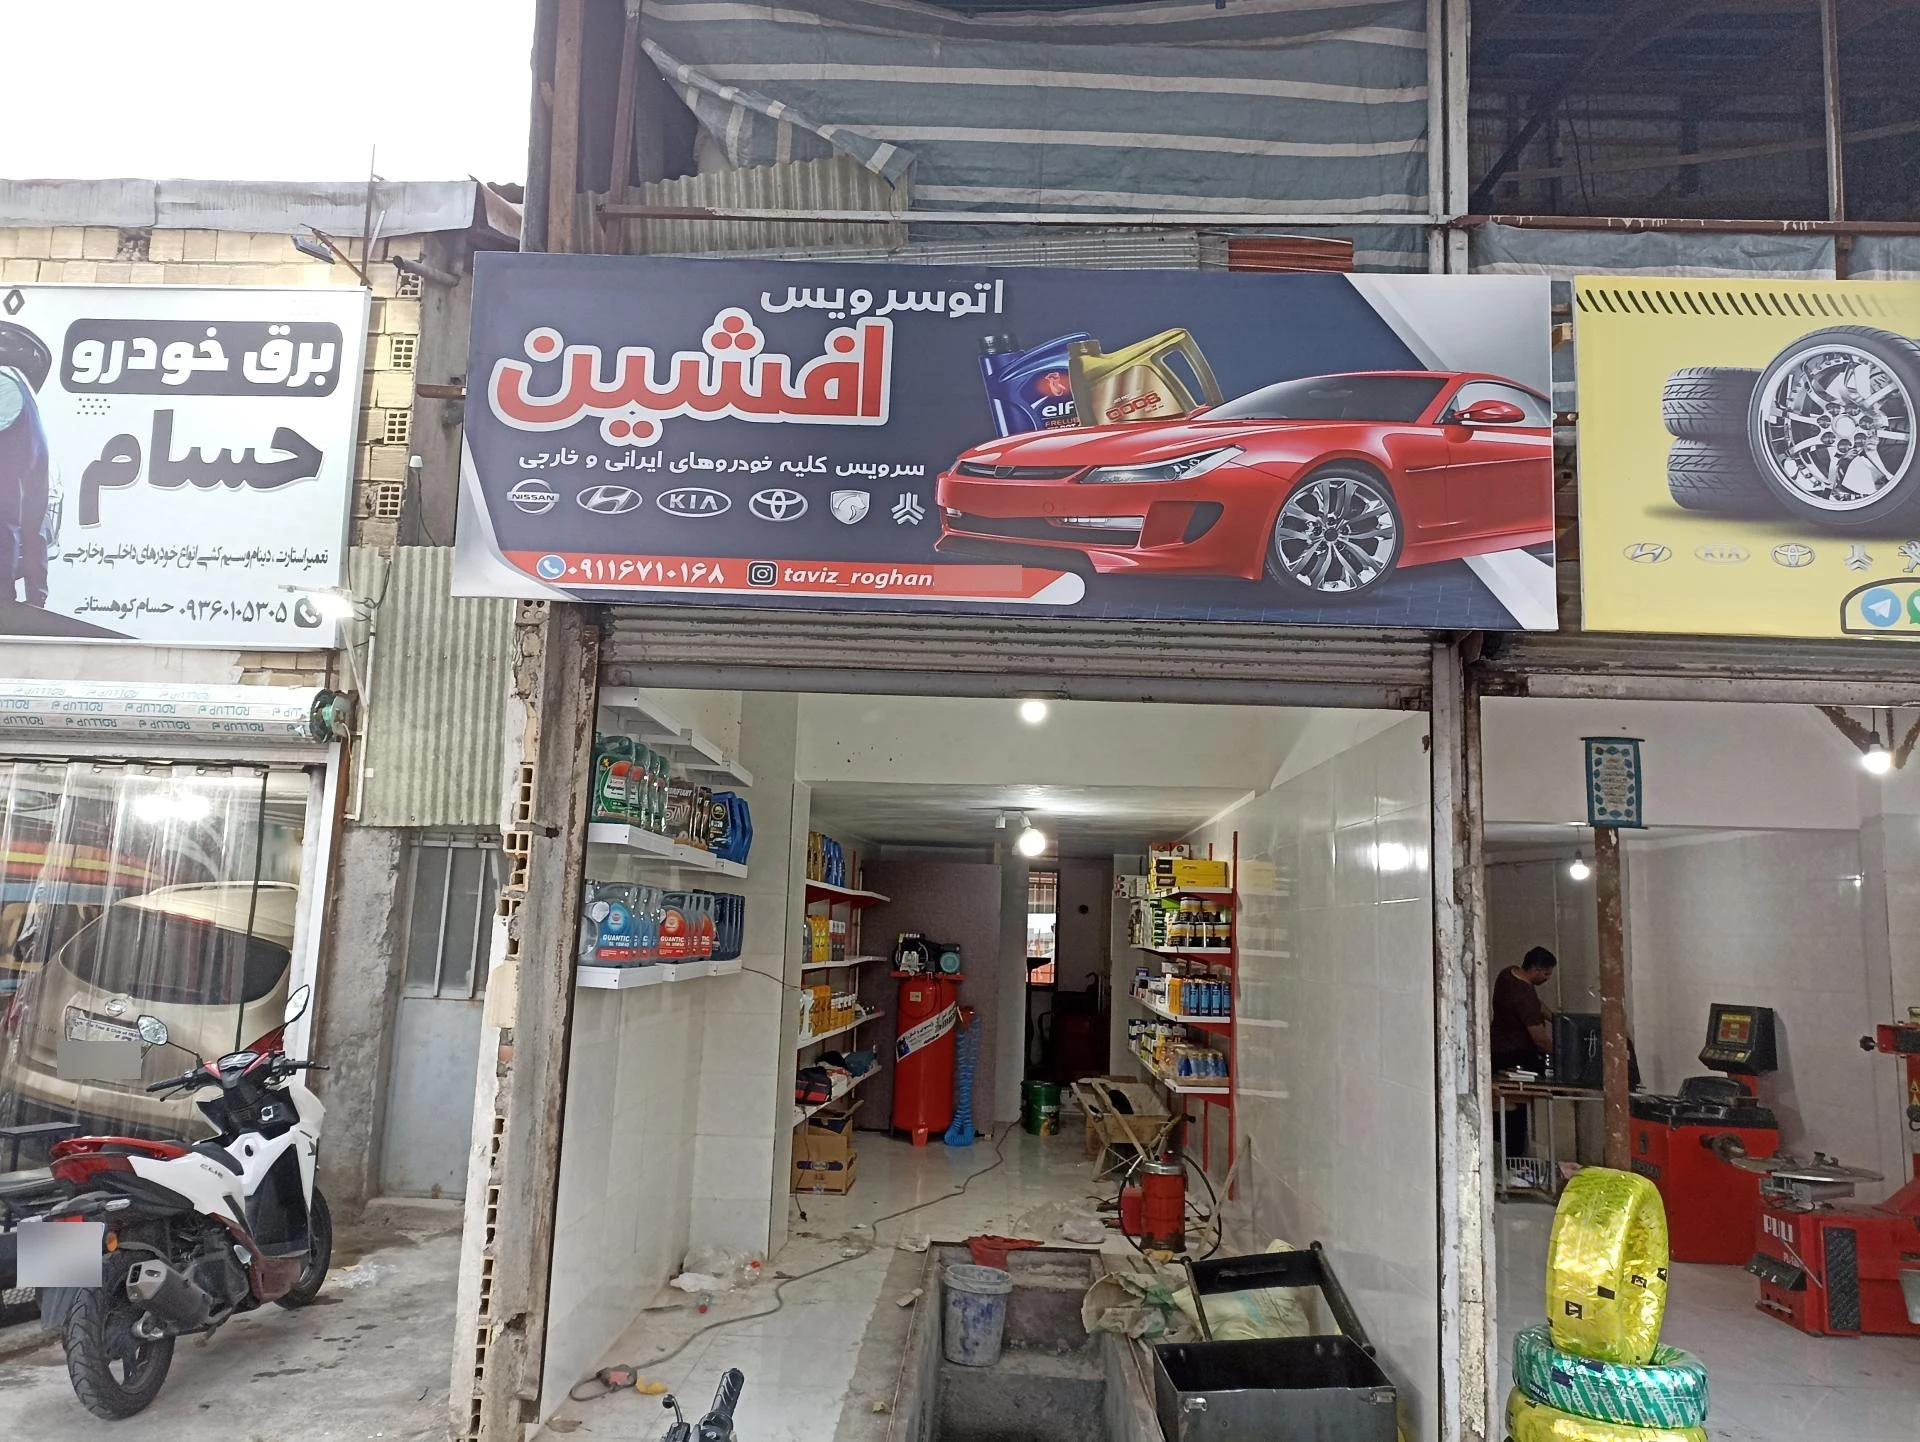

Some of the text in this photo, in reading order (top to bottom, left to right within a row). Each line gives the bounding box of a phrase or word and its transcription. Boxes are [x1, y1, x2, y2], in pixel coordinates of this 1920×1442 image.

[760, 279, 1004, 320] اتوسرویس
[71, 324, 336, 388] برق خودرو
[488, 307, 894, 448] افشین
[1041, 400, 1074, 417] elf
[78, 408, 324, 528] حسام
[518, 447, 925, 480] سرویس کلیه خودروهای ایرانی و خارجی
[511, 492, 556, 502] NISSAN
[669, 493, 719, 511] KIA
[567, 558, 725, 585] ۰۹۱۱۶۷۱۰۱۶۸
[784, 567, 935, 589] taviz_roghan
[179, 599, 287, 623] ۰۹۳۶۰۱۰۵۳۰۵
[63, 700, 104, 712] ROLLUP
[136, 702, 176, 714] ROLLUP
[210, 703, 250, 716] ROLLUP
[3, 716, 265, 732] ROLLUP ROLLUP ROLLUP ROLLUP
[602, 934, 631, 942] QUANTIC
